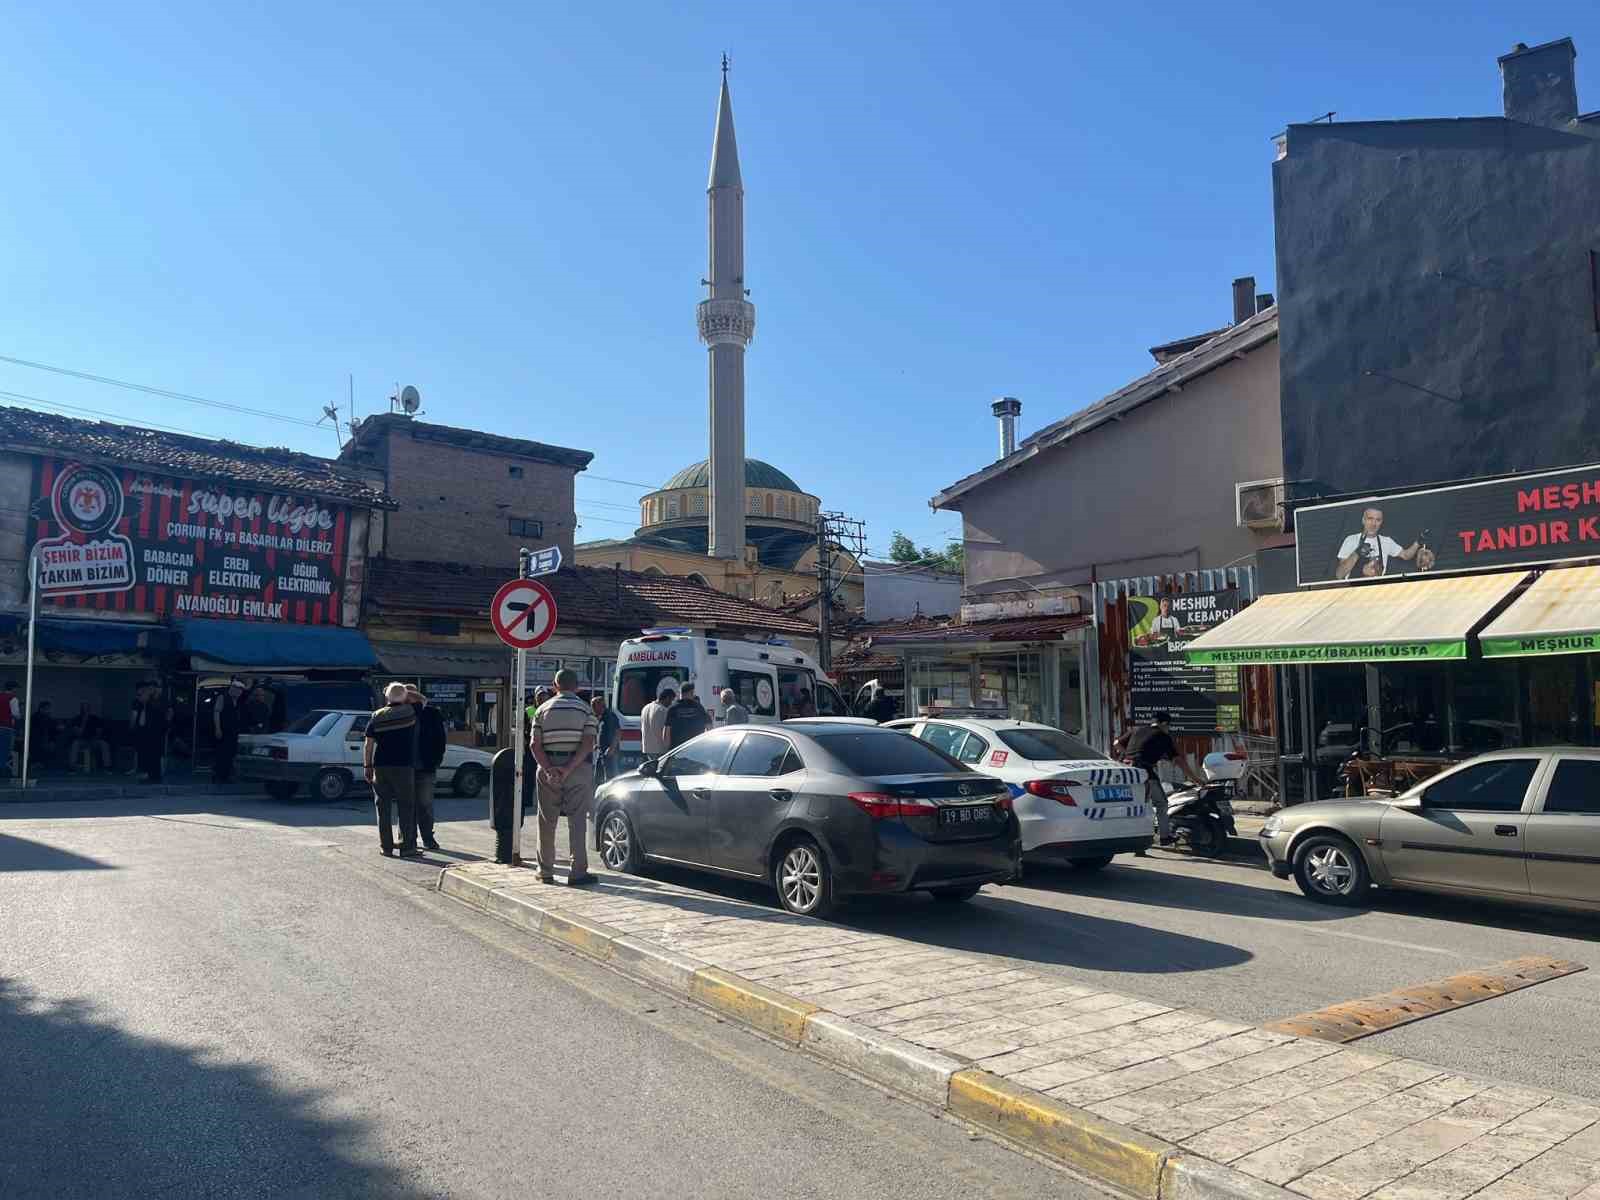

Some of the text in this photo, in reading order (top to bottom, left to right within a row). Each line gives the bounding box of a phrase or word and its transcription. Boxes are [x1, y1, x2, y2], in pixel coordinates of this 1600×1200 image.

[1517, 480, 1600, 513] MEŞH
[209, 527, 223, 541] FK
[1458, 520, 1570, 553] TANDIR
[43, 543, 123, 564] ŞEHİR BİZİM
[144, 550, 194, 567] BABACAN
[223, 556, 249, 571] EREN
[292, 561, 318, 578] UĞUR
[41, 563, 125, 584] TAKIM BİZİM
[147, 566, 189, 585] DÖNER
[209, 570, 262, 589] ELEKTRİK
[278, 576, 331, 594] ELEKTRONİK
[176, 594, 283, 618] AYANOĞLU EMLAK
[1521, 637, 1594, 652] MEŞHUR
[627, 650, 678, 662] AMBULANS
[1211, 650, 1262, 663] MEŞHUR
[1390, 645, 1429, 657] USTA
